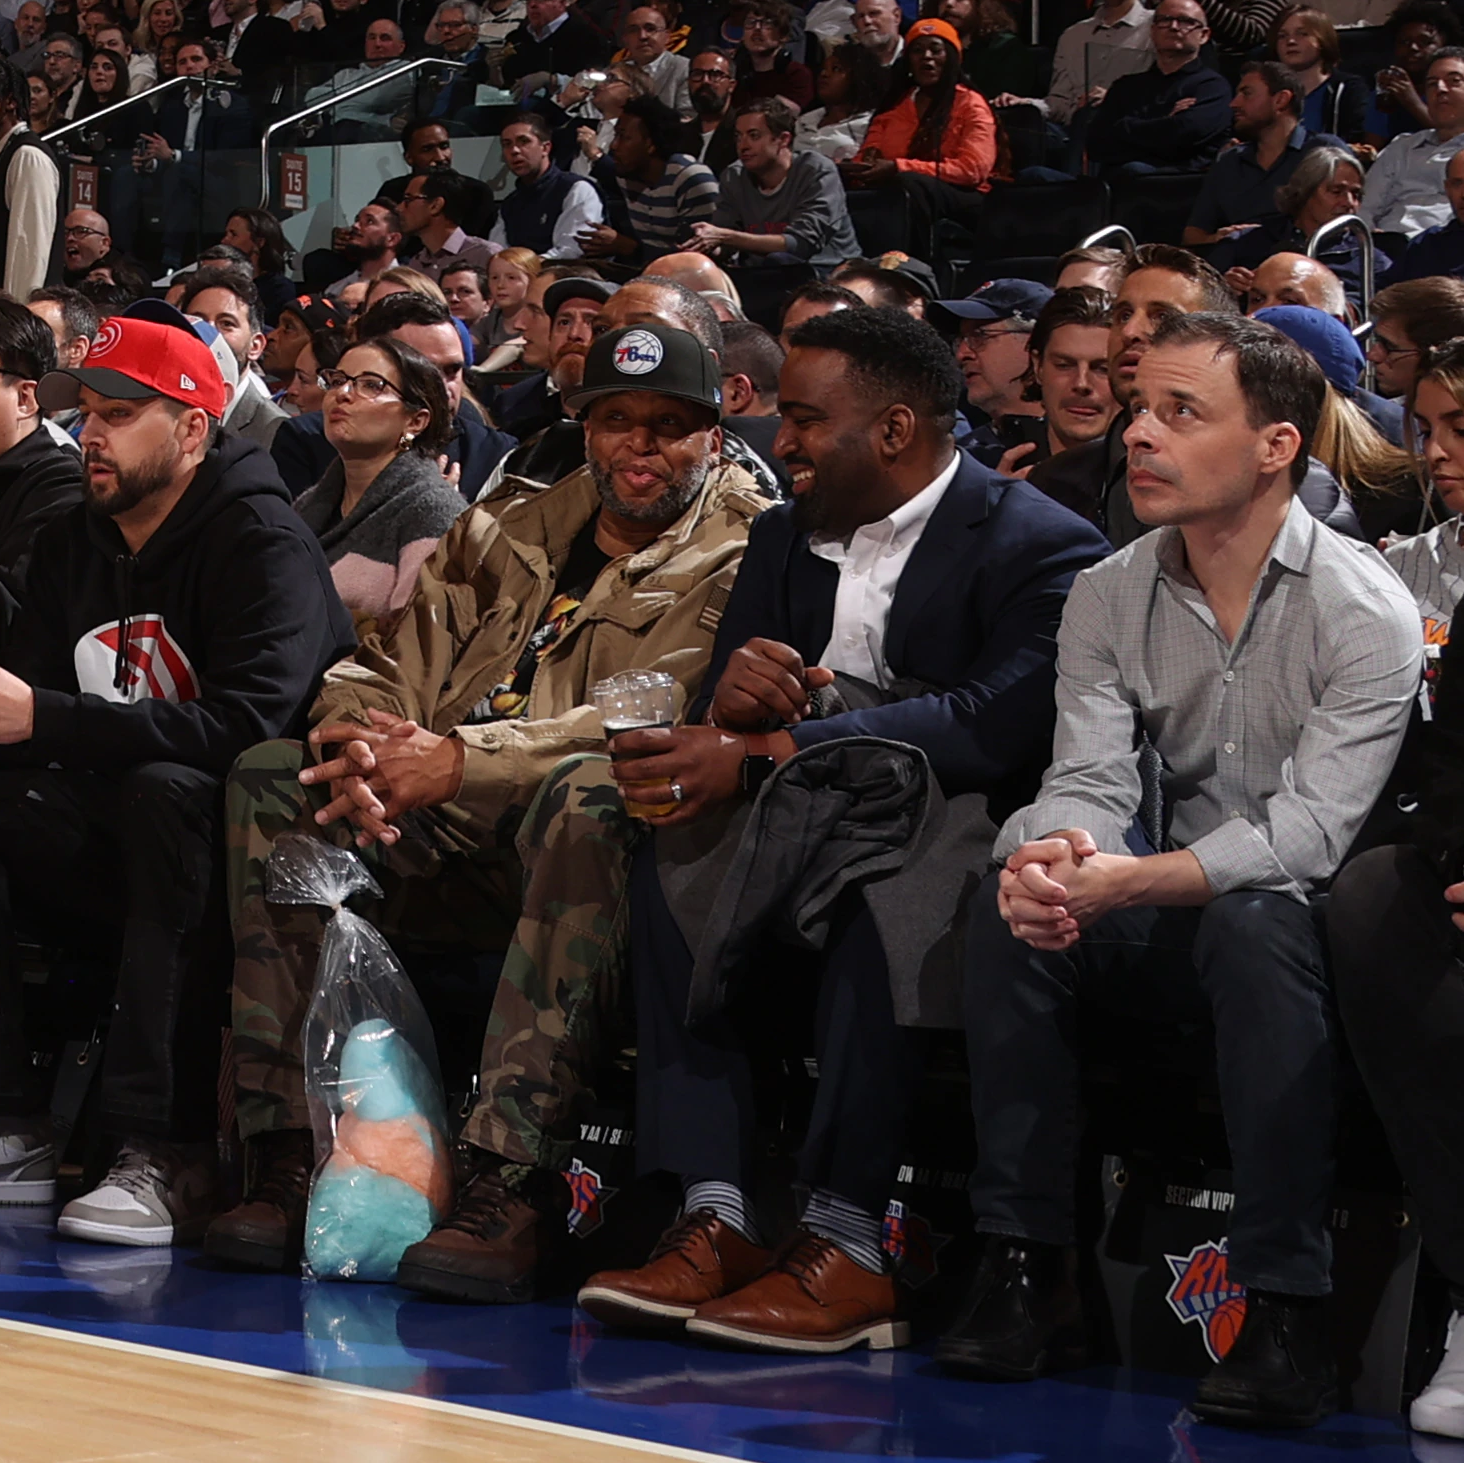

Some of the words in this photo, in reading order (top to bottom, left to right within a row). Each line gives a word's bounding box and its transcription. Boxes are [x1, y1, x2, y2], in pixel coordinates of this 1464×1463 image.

[77, 182, 92, 202] 14
[286, 171, 302, 192] 15
[1165, 1184, 1211, 1211] SECTION
